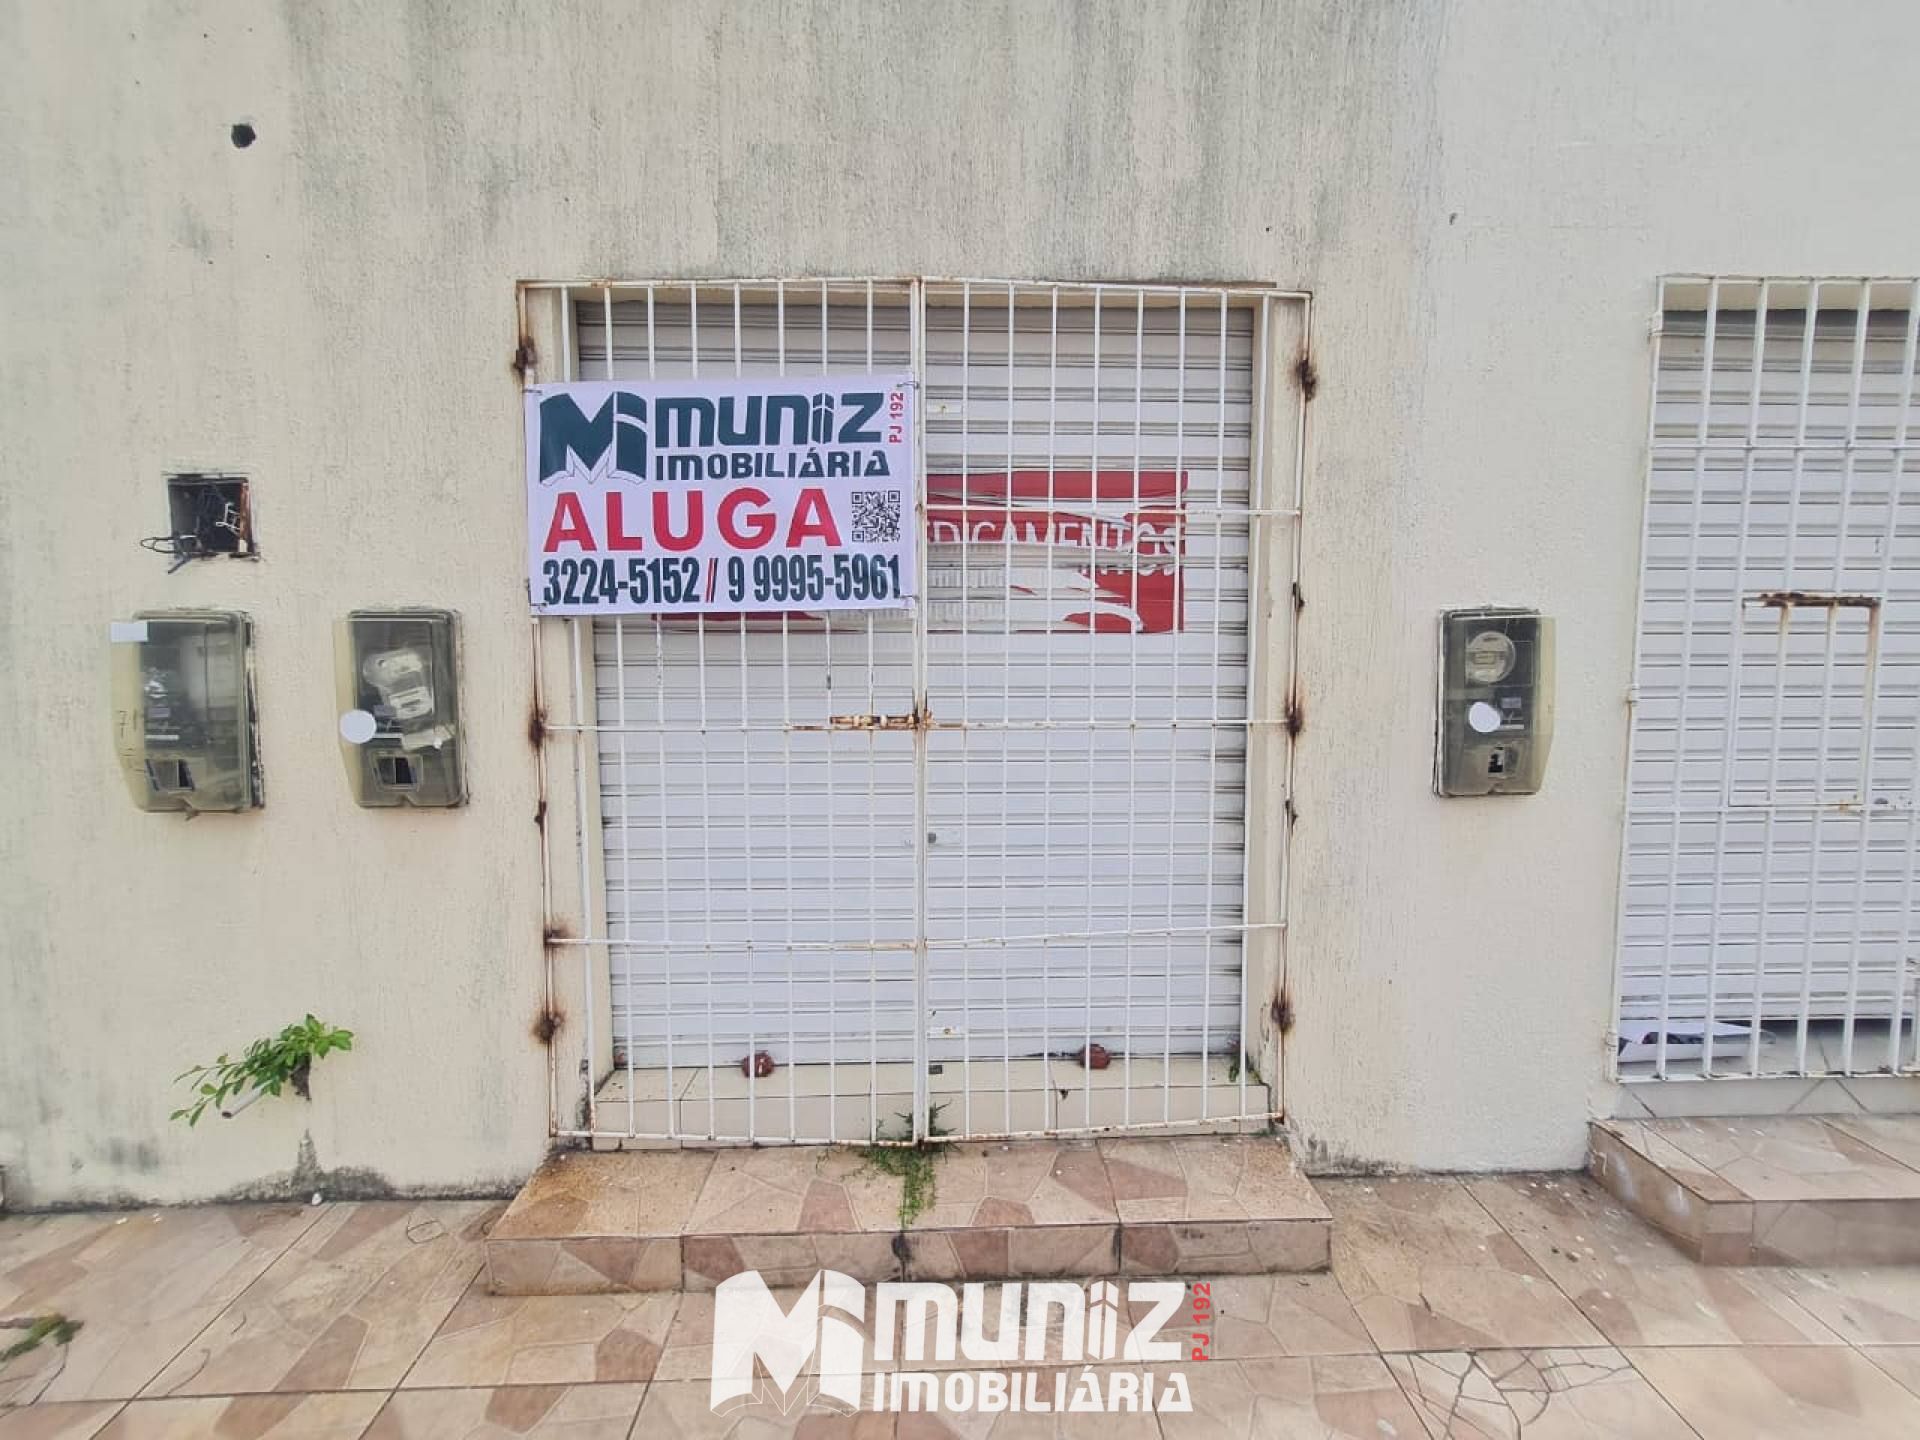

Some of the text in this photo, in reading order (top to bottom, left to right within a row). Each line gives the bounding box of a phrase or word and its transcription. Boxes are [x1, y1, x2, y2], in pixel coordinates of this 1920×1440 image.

[889, 392, 904, 443] PJ 192
[543, 487, 842, 553] ALUGA
[543, 558, 700, 605] 3224-5152
[728, 558, 745, 601] 9
[754, 554, 901, 601] 9995-5961
